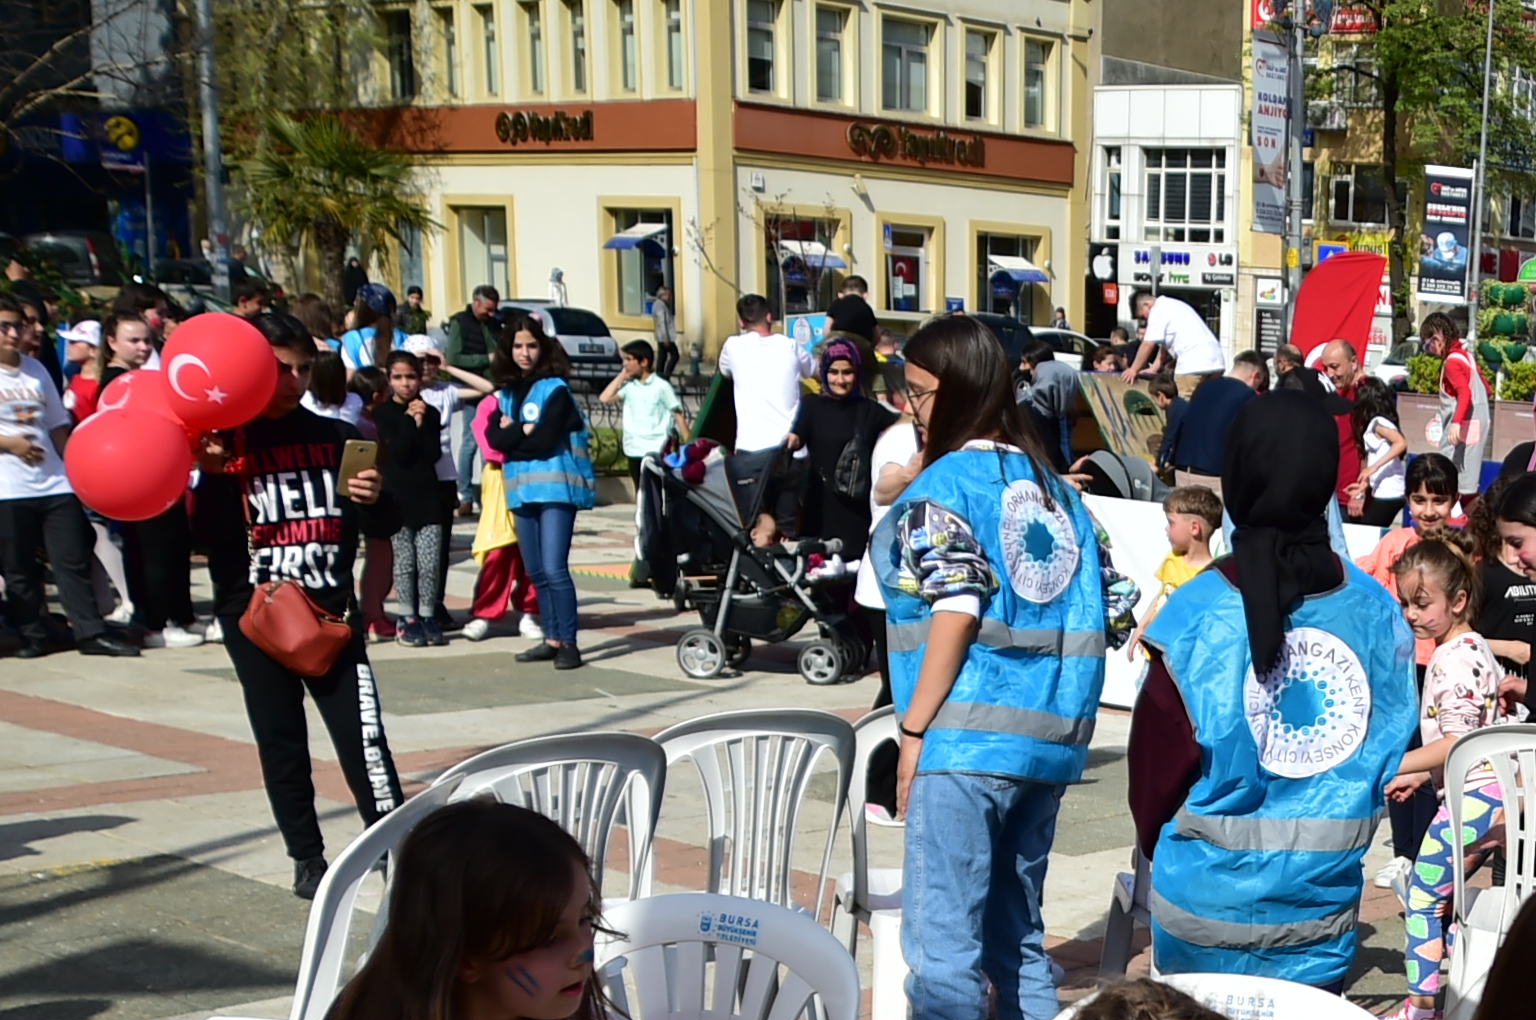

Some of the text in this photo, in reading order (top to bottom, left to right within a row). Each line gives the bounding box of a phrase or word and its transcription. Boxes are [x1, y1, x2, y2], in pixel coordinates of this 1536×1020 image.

[1256, 136, 1276, 149] SON
[1134, 250, 1190, 266] SASUNG
[247, 469, 342, 524] WELL
[248, 542, 340, 590] FIRST
[1345, 673, 1365, 718] KENT
[1301, 722, 1361, 764] KONSEYİ
[1266, 749, 1298, 764] CITY
[719, 913, 759, 929] BURSA
[1226, 995, 1275, 1009] BURSA
